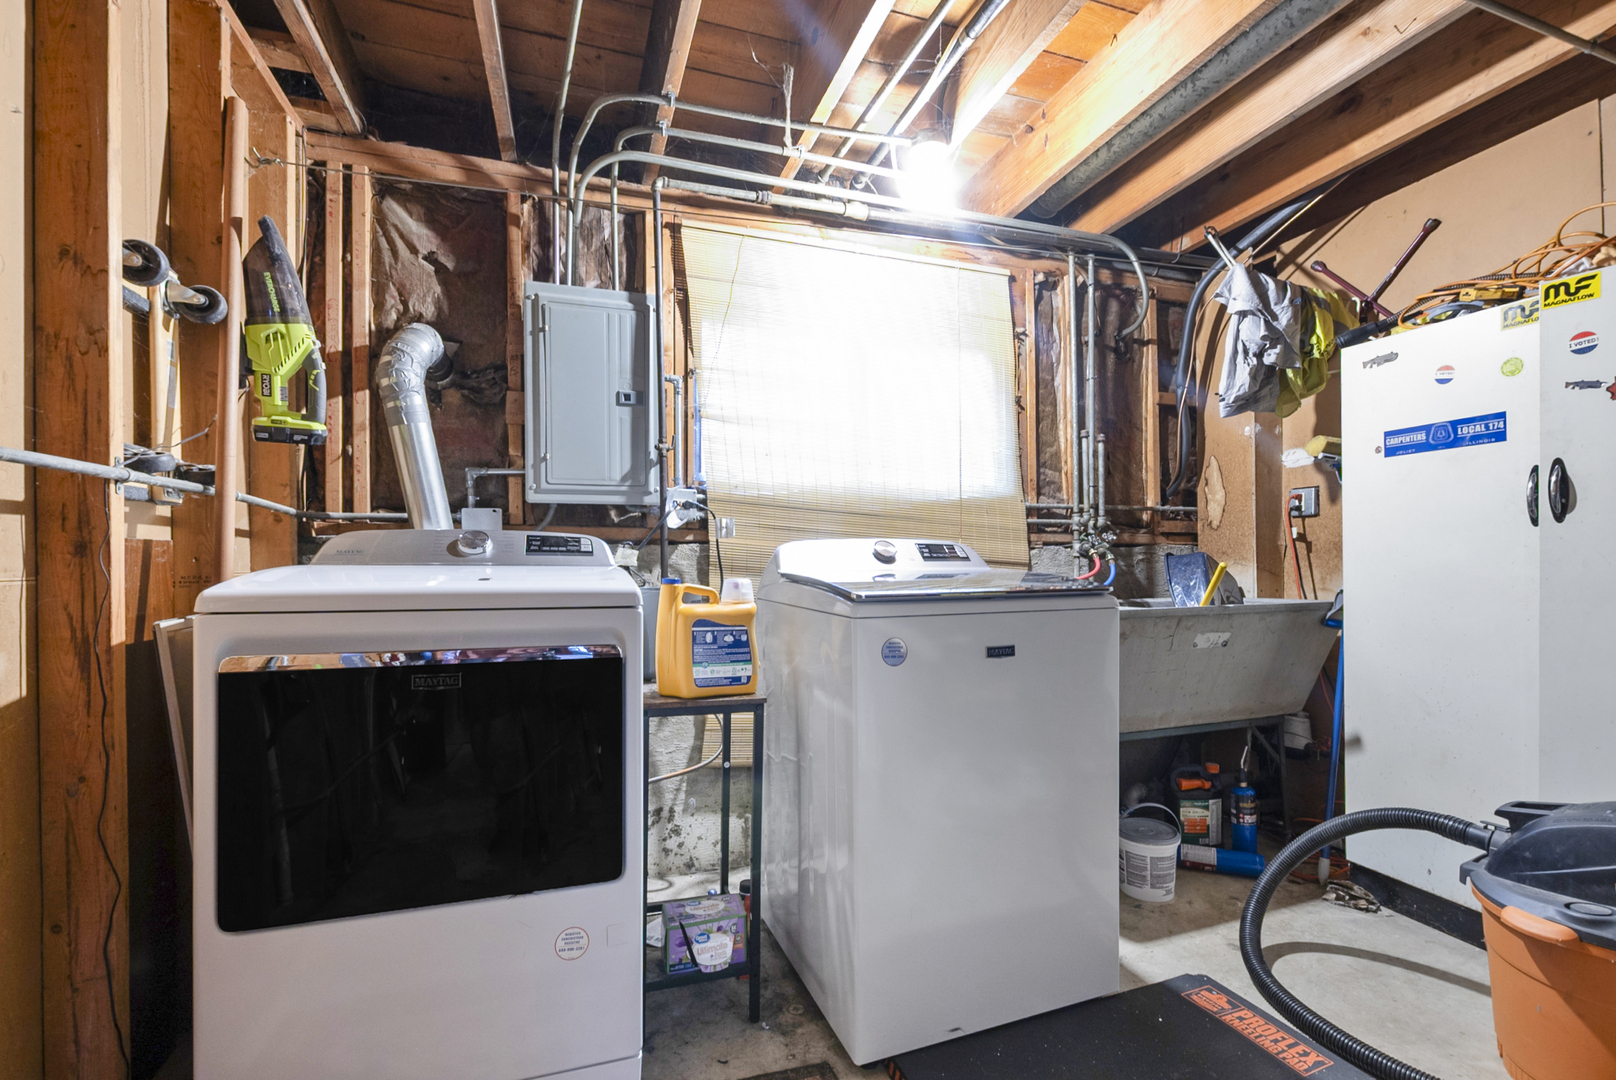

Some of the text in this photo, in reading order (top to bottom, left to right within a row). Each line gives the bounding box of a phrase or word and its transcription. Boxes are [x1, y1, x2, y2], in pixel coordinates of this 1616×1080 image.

[263, 271, 281, 313] EVERCHARGE
[1543, 292, 1595, 308] MAGNAFLOW
[1503, 316, 1539, 329] MAGNAFLO
[262, 374, 271, 396] RYOBI
[1386, 420, 1504, 446] CARPENTERS LOCAL 174
[989, 647, 1015, 657] MAYTAG
[414, 676, 458, 687] MAYTAG
[697, 942, 728, 956] Ultimate
[1221, 1014, 1283, 1055] KNEELING
[1230, 1009, 1329, 1067] PROFLEX
